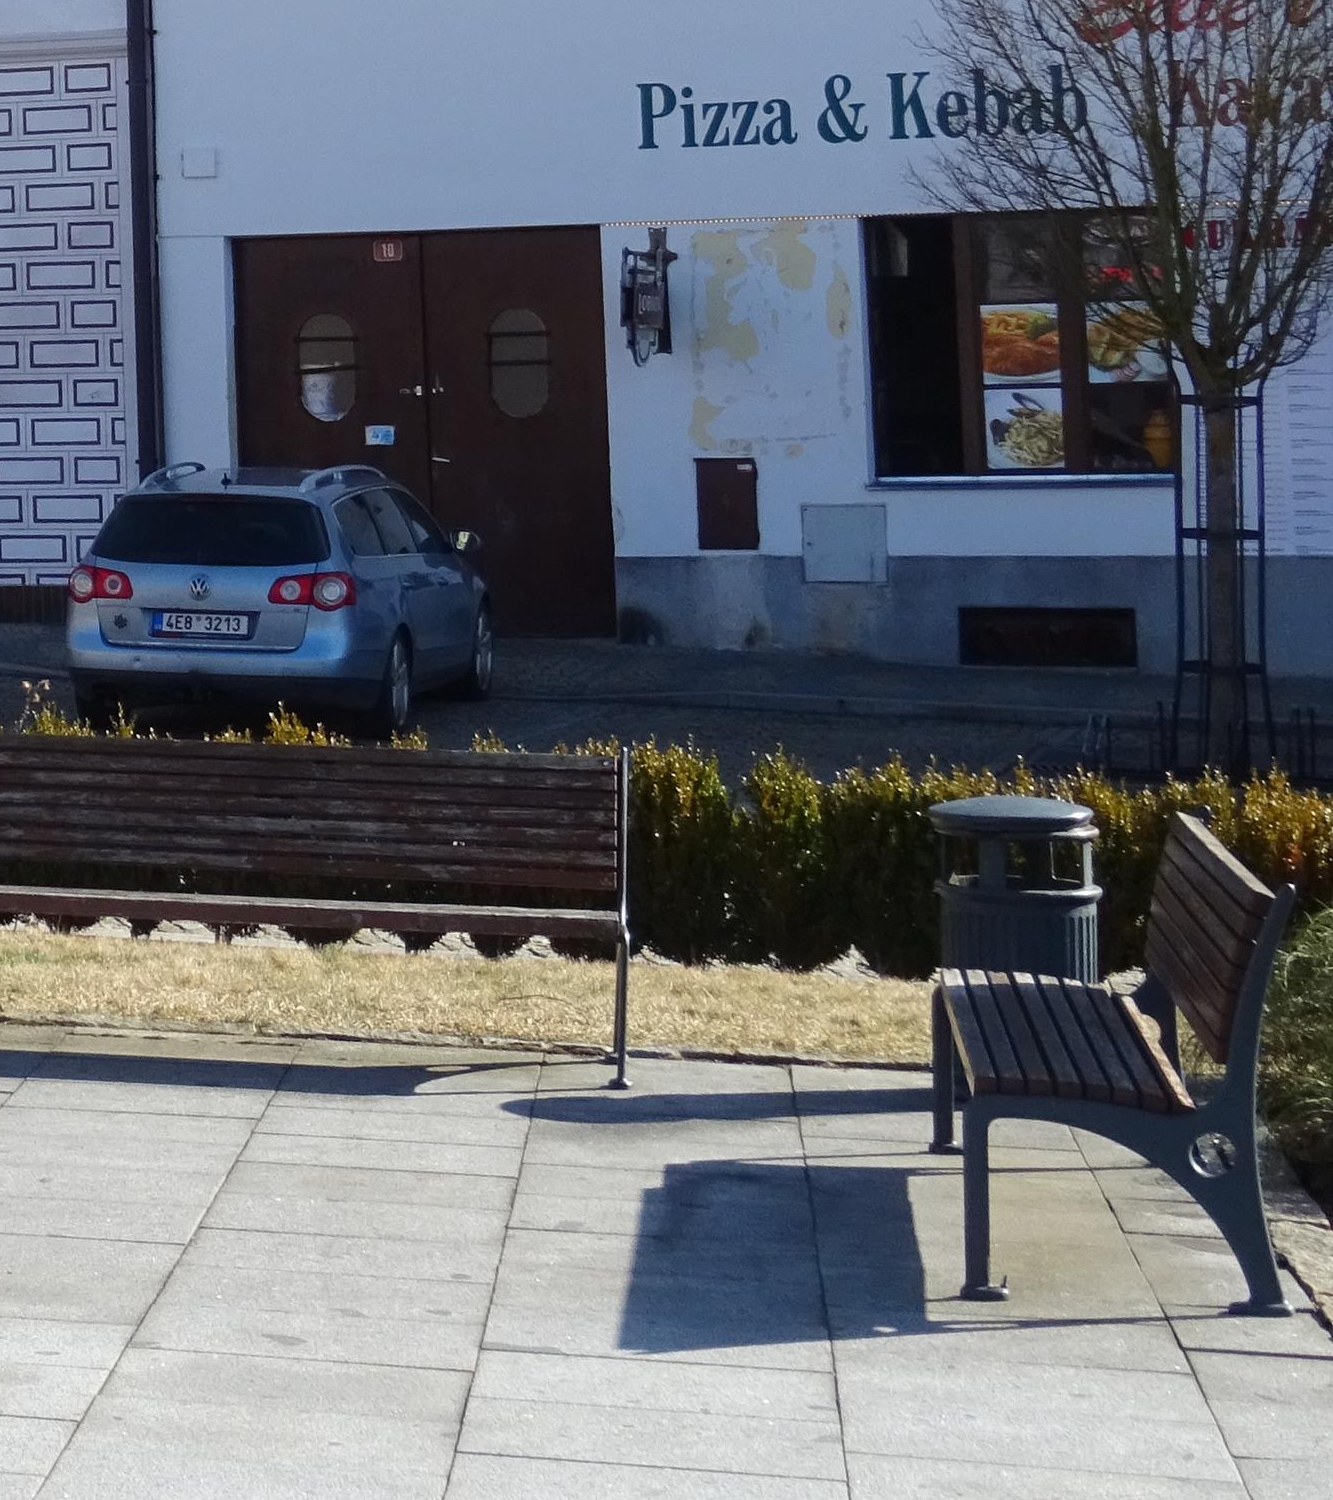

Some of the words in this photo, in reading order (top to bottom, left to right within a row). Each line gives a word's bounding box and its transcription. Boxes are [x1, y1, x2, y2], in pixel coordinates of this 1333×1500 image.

[636, 82, 798, 150] Pizza
[817, 74, 869, 143] &
[886, 64, 1089, 142] Kebab
[382, 243, 394, 258] 10
[165, 615, 193, 630] 4E8
[204, 615, 241, 632] 3213
